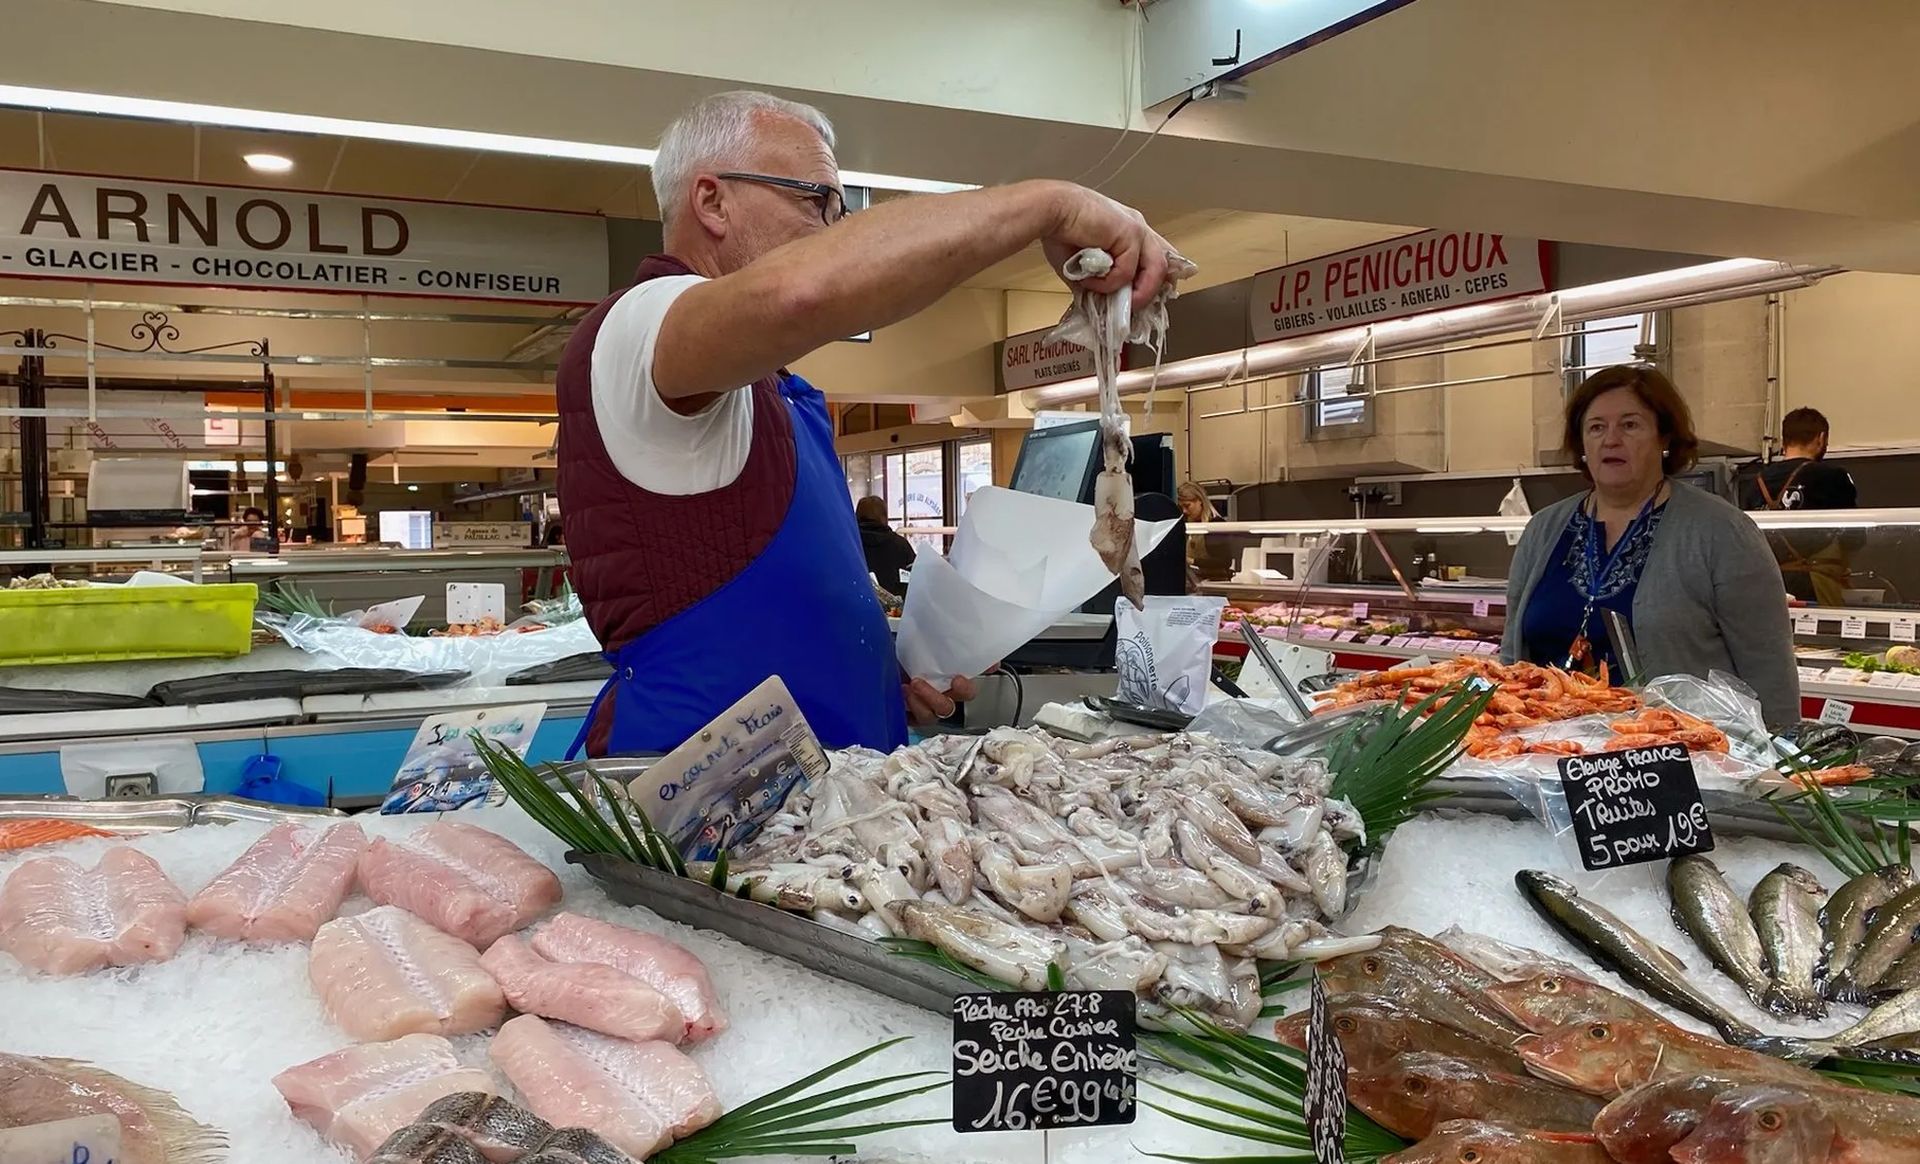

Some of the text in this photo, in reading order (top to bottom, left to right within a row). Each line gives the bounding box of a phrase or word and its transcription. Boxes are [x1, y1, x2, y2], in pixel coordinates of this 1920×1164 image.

[20, 182, 410, 257] ARNOLD
[25, 247, 159, 274] GLACIER
[192, 256, 388, 285] CHOCOLATIER
[417, 269, 561, 295] CONFISEUR
[1270, 232, 1508, 314] J.P. PENICHOUX
[1274, 311, 1316, 332] GIBIERS
[1326, 296, 1387, 322] VOLAILLES
[1400, 284, 1450, 308] AGNEAU
[1465, 272, 1508, 295] CEPES
[1006, 345, 1030, 368] SARL
[1034, 364, 1053, 379] PLATS
[1585, 770, 1660, 801] PROMO
[1590, 834, 1611, 865] 5
[1613, 833, 1660, 863] pour
[953, 995, 1012, 1022] Pêche
[953, 1040, 1048, 1076] Seiche
